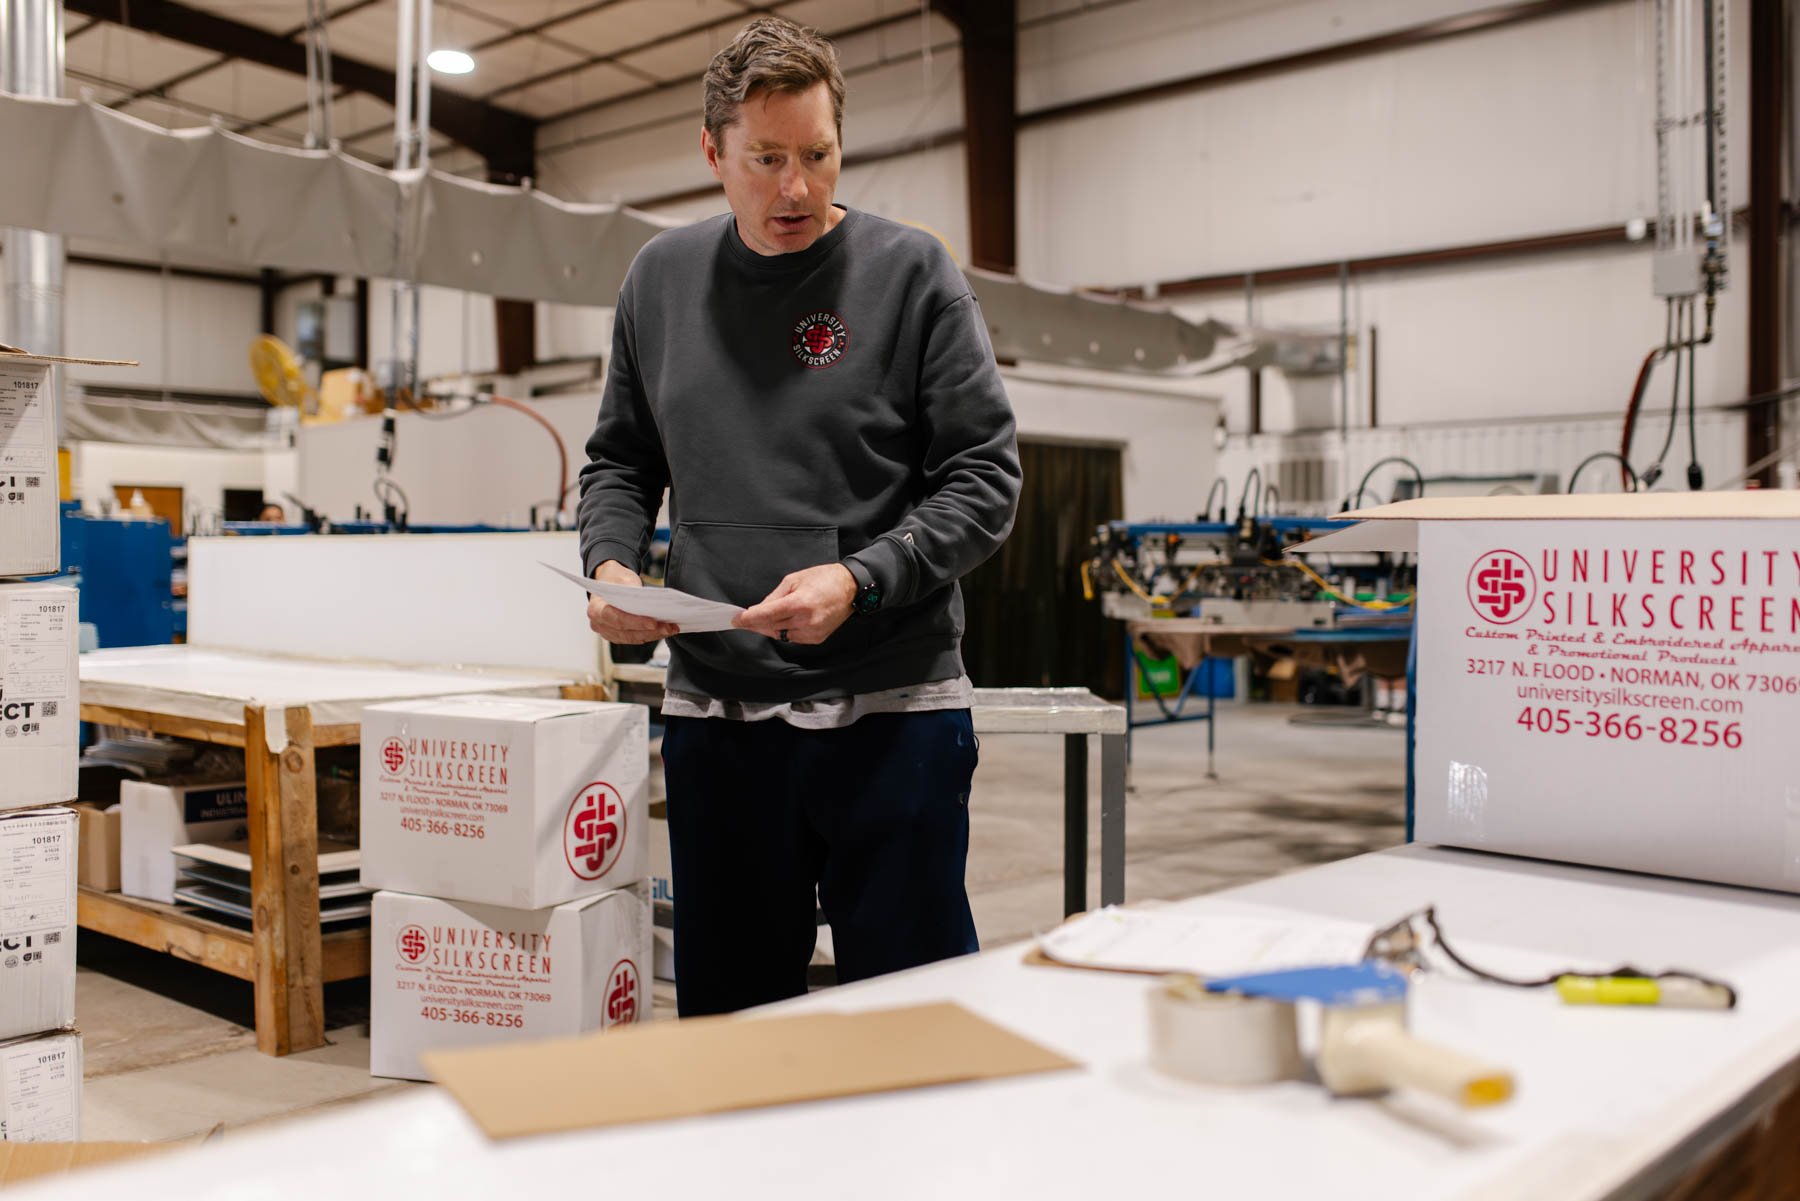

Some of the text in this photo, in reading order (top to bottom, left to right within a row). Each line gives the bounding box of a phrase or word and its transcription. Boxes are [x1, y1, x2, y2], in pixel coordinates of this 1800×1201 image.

[795, 313, 846, 337] UNIVERSITY
[793, 344, 841, 366] SILKSCREEN
[13, 381, 39, 390] 101817
[39, 605, 65, 613] 101817
[1543, 591, 1800, 634] SILKSCREEN
[1465, 626, 1519, 639] Custom
[1526, 629, 1586, 643] Printed
[1593, 632, 1605, 644] &
[1612, 633, 1724, 650] Embroidered
[1528, 644, 1739, 665] & Promotional Products
[1466, 658, 1505, 675] 3217
[1512, 661, 1528, 677] N.
[1534, 662, 1595, 681] FLOOD
[1610, 667, 1704, 690] NORMAN,
[1711, 673, 1740, 690] OK
[1517, 683, 1744, 714] universitysilkscreen.com
[1517, 706, 1742, 749] 405-366-8256
[409, 738, 508, 763] UNIVERSITY
[410, 759, 507, 785] SILKSCREEN
[406, 795, 430, 804] FLOOD
[472, 802, 482, 811] OK
[400, 816, 485, 839] 405-366-8256
[32, 835, 61, 845] 101817
[433, 926, 552, 952] UNIVERSITY
[433, 948, 551, 974] SILKSCREEN
[396, 980, 416, 990] 3217
[428, 984, 457, 995] FLOOD
[509, 990, 521, 1000] OK
[524, 992, 552, 1002] 73069
[420, 995, 524, 1011] universitysilkscreen.com
[421, 1006, 523, 1028] 405-366-8256
[38, 1051, 66, 1064] 101817
